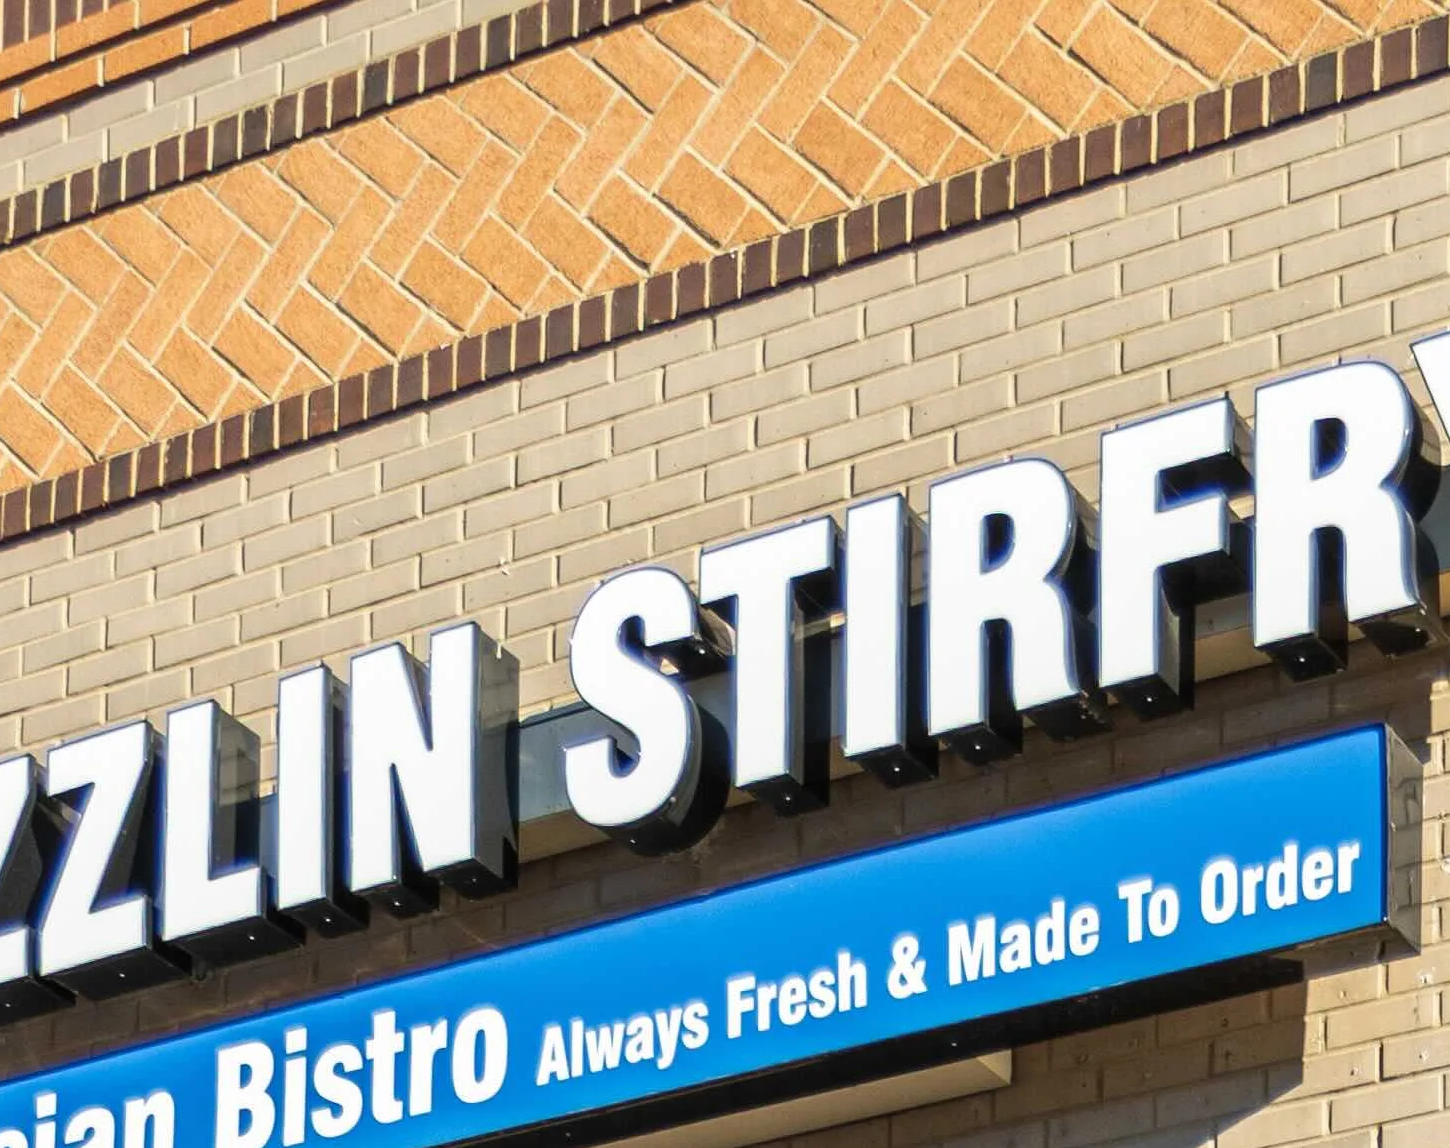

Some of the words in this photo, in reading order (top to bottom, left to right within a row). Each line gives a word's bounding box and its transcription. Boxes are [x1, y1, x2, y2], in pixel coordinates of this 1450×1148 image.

[535, 998, 710, 1087] Always
[725, 950, 868, 1040] Fresh
[887, 934, 928, 998] &
[947, 898, 1100, 986] Made
[1118, 876, 1180, 943] To
[1199, 840, 1361, 924] Order
